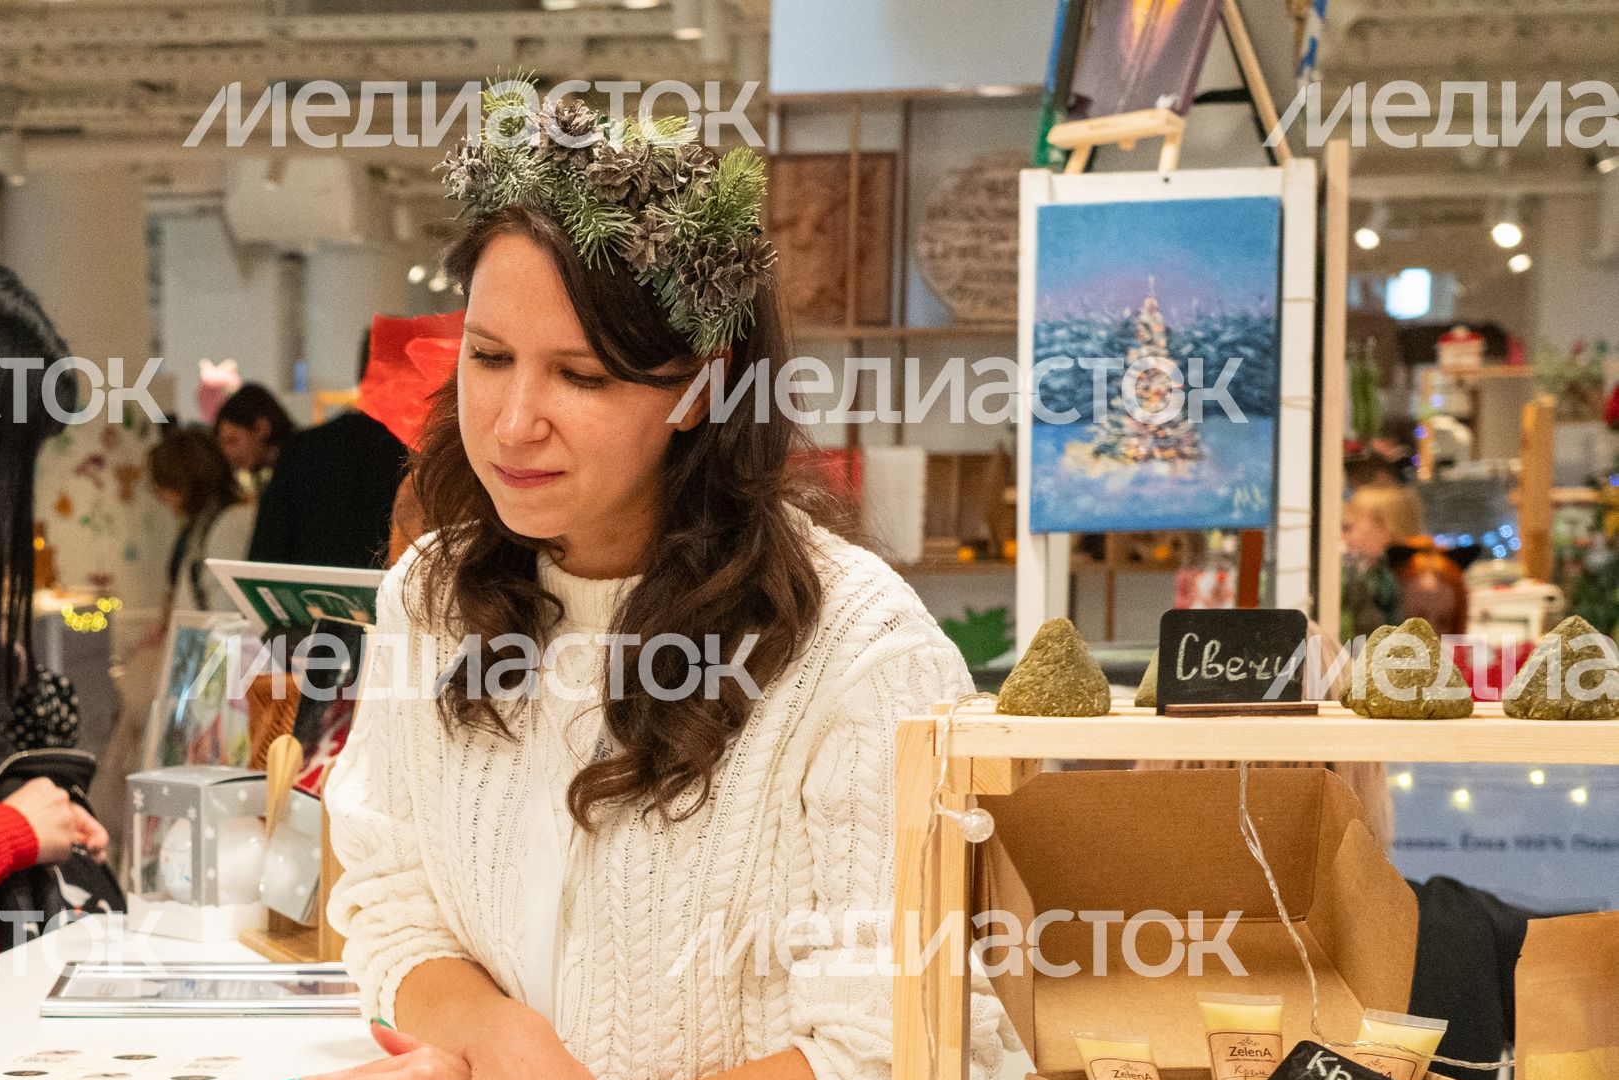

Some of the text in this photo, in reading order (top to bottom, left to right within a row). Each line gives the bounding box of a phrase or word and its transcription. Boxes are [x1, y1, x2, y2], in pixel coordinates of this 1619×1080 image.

[1176, 632, 1296, 682] Свечи
[1229, 1046, 1273, 1058] ZelenA
[1111, 1069, 1154, 1080] ZelenA
